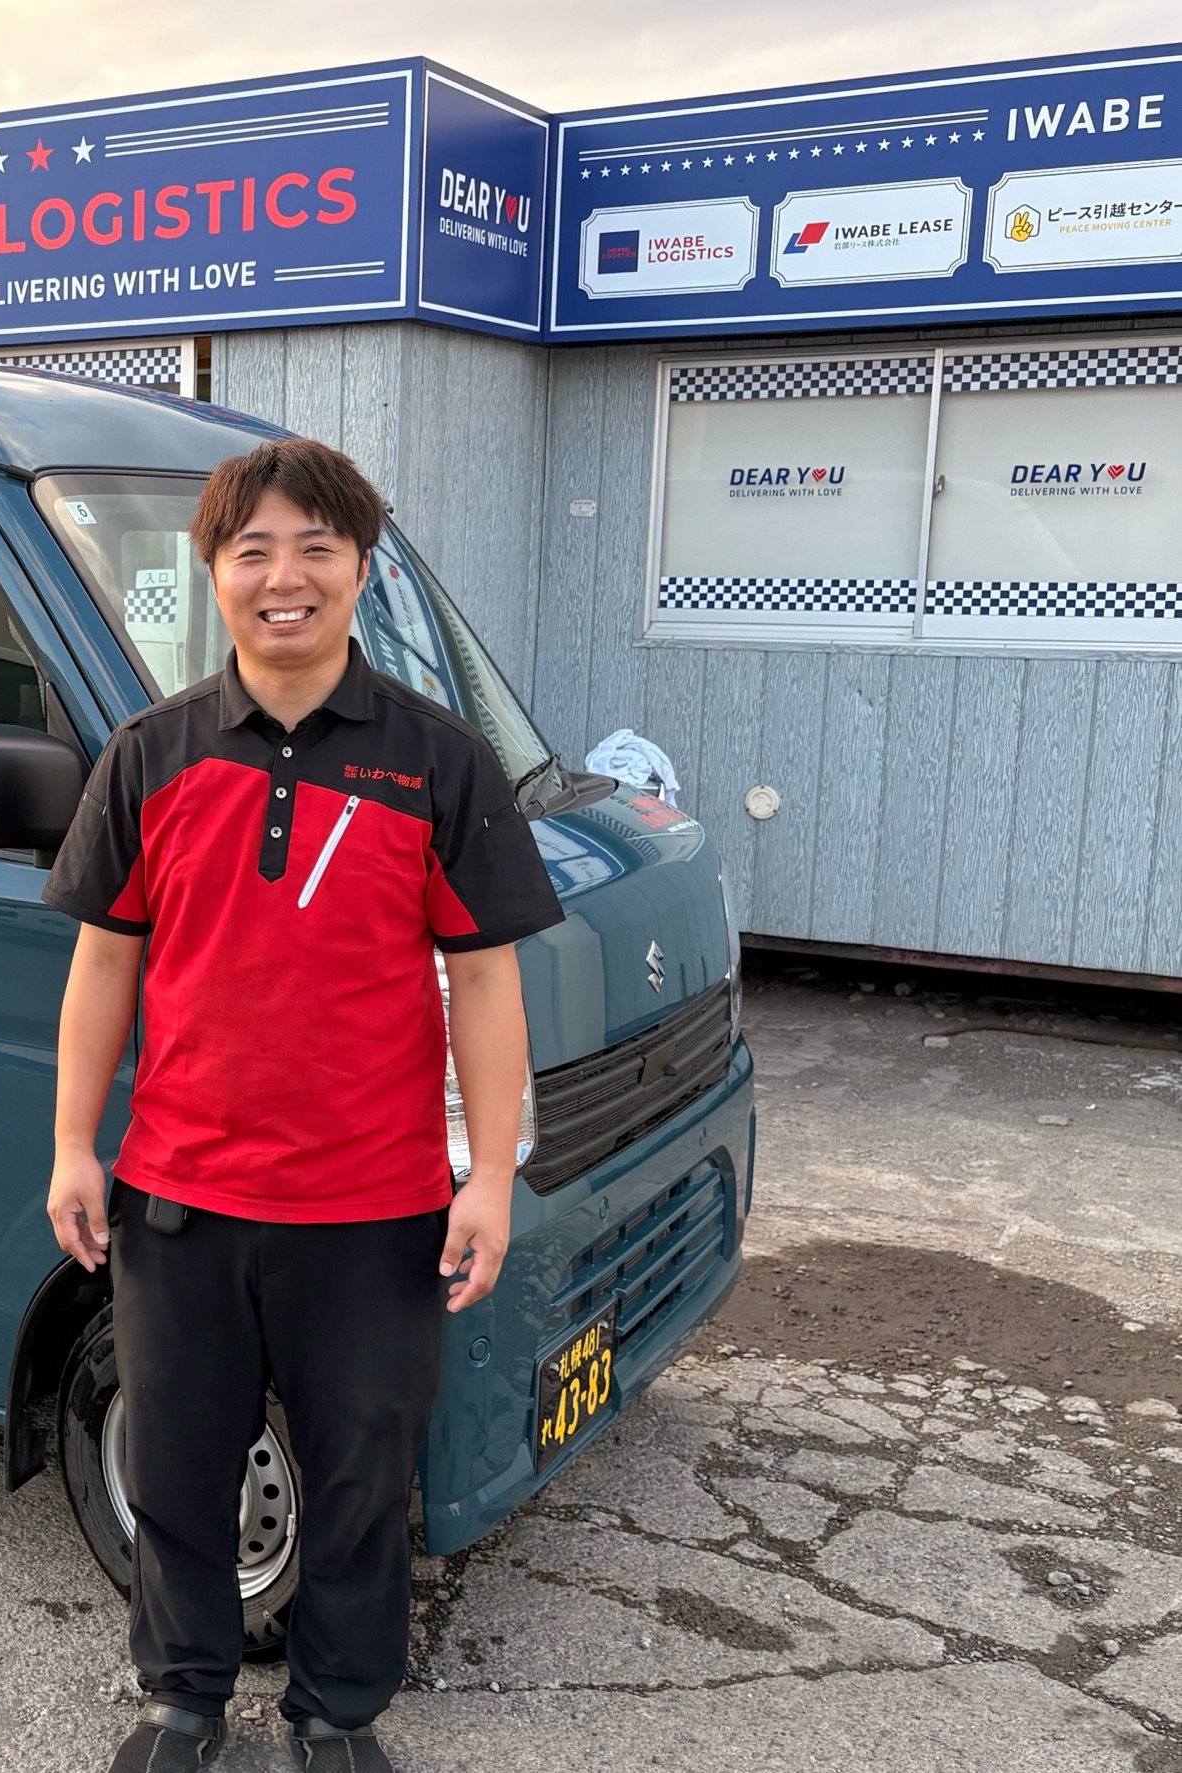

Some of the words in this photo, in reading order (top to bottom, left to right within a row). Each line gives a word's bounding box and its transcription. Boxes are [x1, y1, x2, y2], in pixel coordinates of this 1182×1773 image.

[1007, 93, 1165, 142] IWABE
[440, 167, 491, 221] DEAR
[1047, 199, 1182, 222] ピース引越センター
[834, 223, 891, 240] IWABE
[898, 218, 954, 236] LEASE
[1059, 223, 1090, 234] PEACE
[1092, 221, 1131, 232] MOVING
[1133, 218, 1172, 229] CENTER
[439, 217, 486, 246] DELIVERING
[487, 231, 508, 252] WITH
[508, 238, 528, 258] LOVE
[648, 235, 705, 250] IWABE
[834, 238, 900, 250] 岩部リース株式会社
[648, 246, 734, 264] LOGISTICS
[113, 267, 180, 297] WITH
[189, 261, 257, 291] LOVE
[729, 467, 790, 486] DEAR
[1011, 464, 1082, 484] DEAR
[729, 489, 785, 498] DELIVERING
[788, 488, 815, 497] WITH
[818, 487, 842, 496] LOVE
[1010, 487, 1076, 497] DELIVERING
[1079, 486, 1110, 496] WITH
[1114, 485, 1143, 495] LOVE
[76, 504, 88, 518] 6
[144, 572, 168, 585] 入口
[359, 767, 423, 790] いわべ物流
[554, 1348, 612, 1446] 43-83
